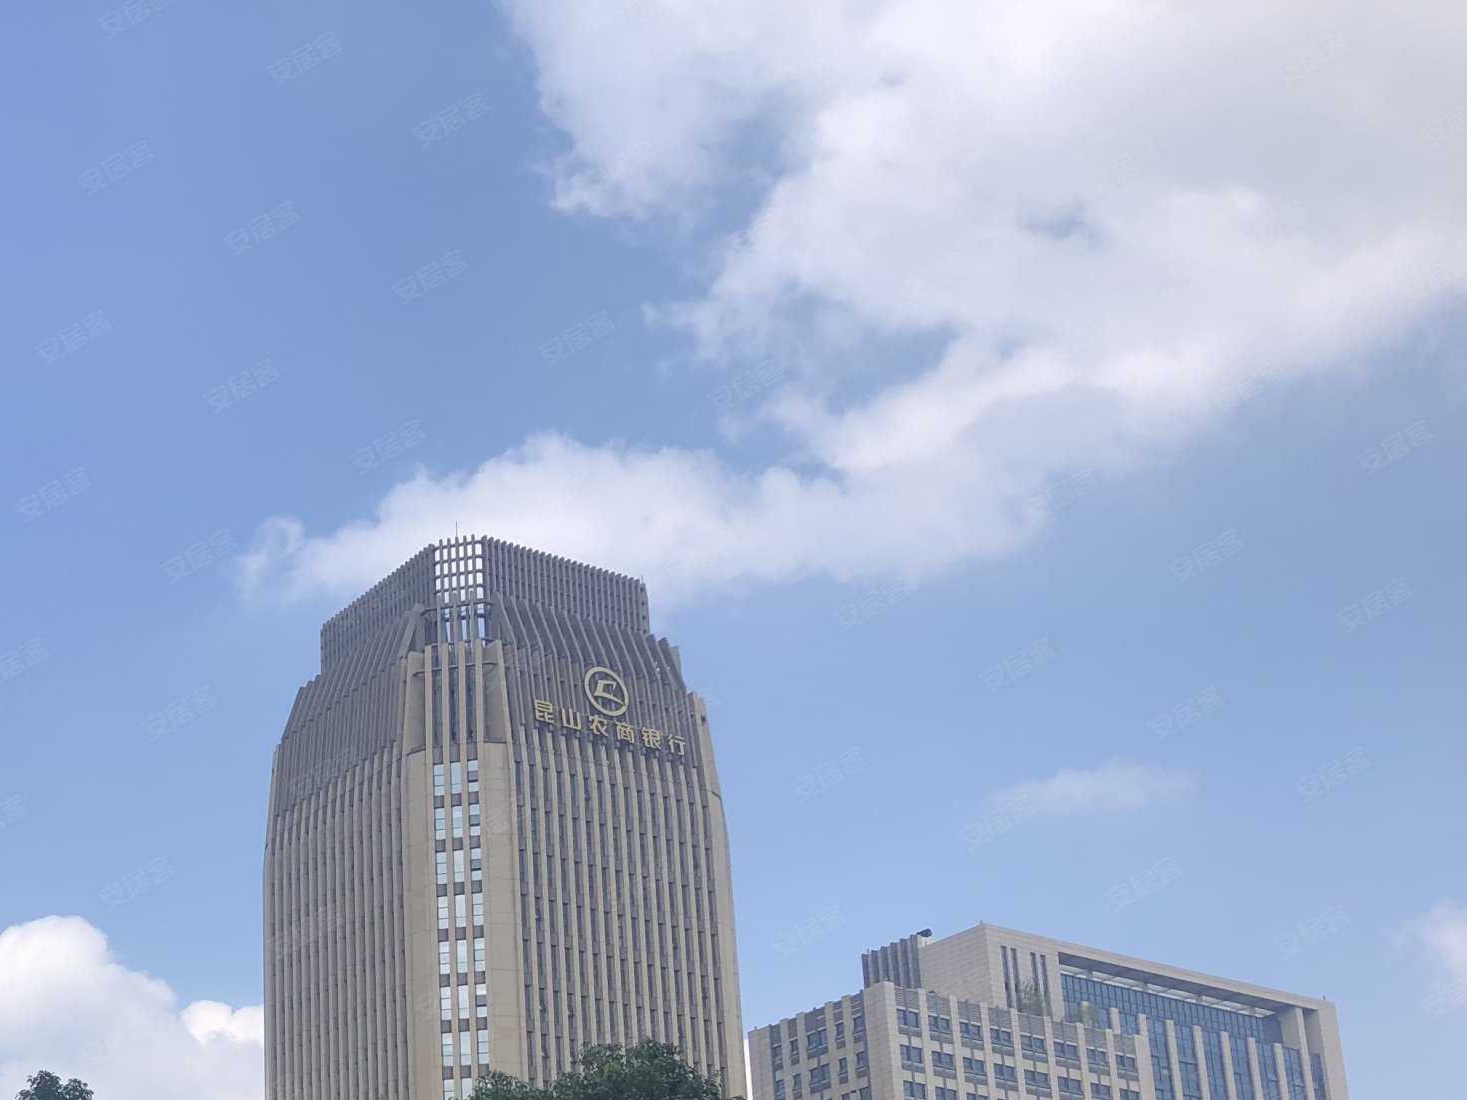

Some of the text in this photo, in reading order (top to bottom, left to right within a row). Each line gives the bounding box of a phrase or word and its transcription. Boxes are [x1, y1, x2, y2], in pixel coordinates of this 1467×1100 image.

[534, 699, 686, 756] 昆山农商银行
